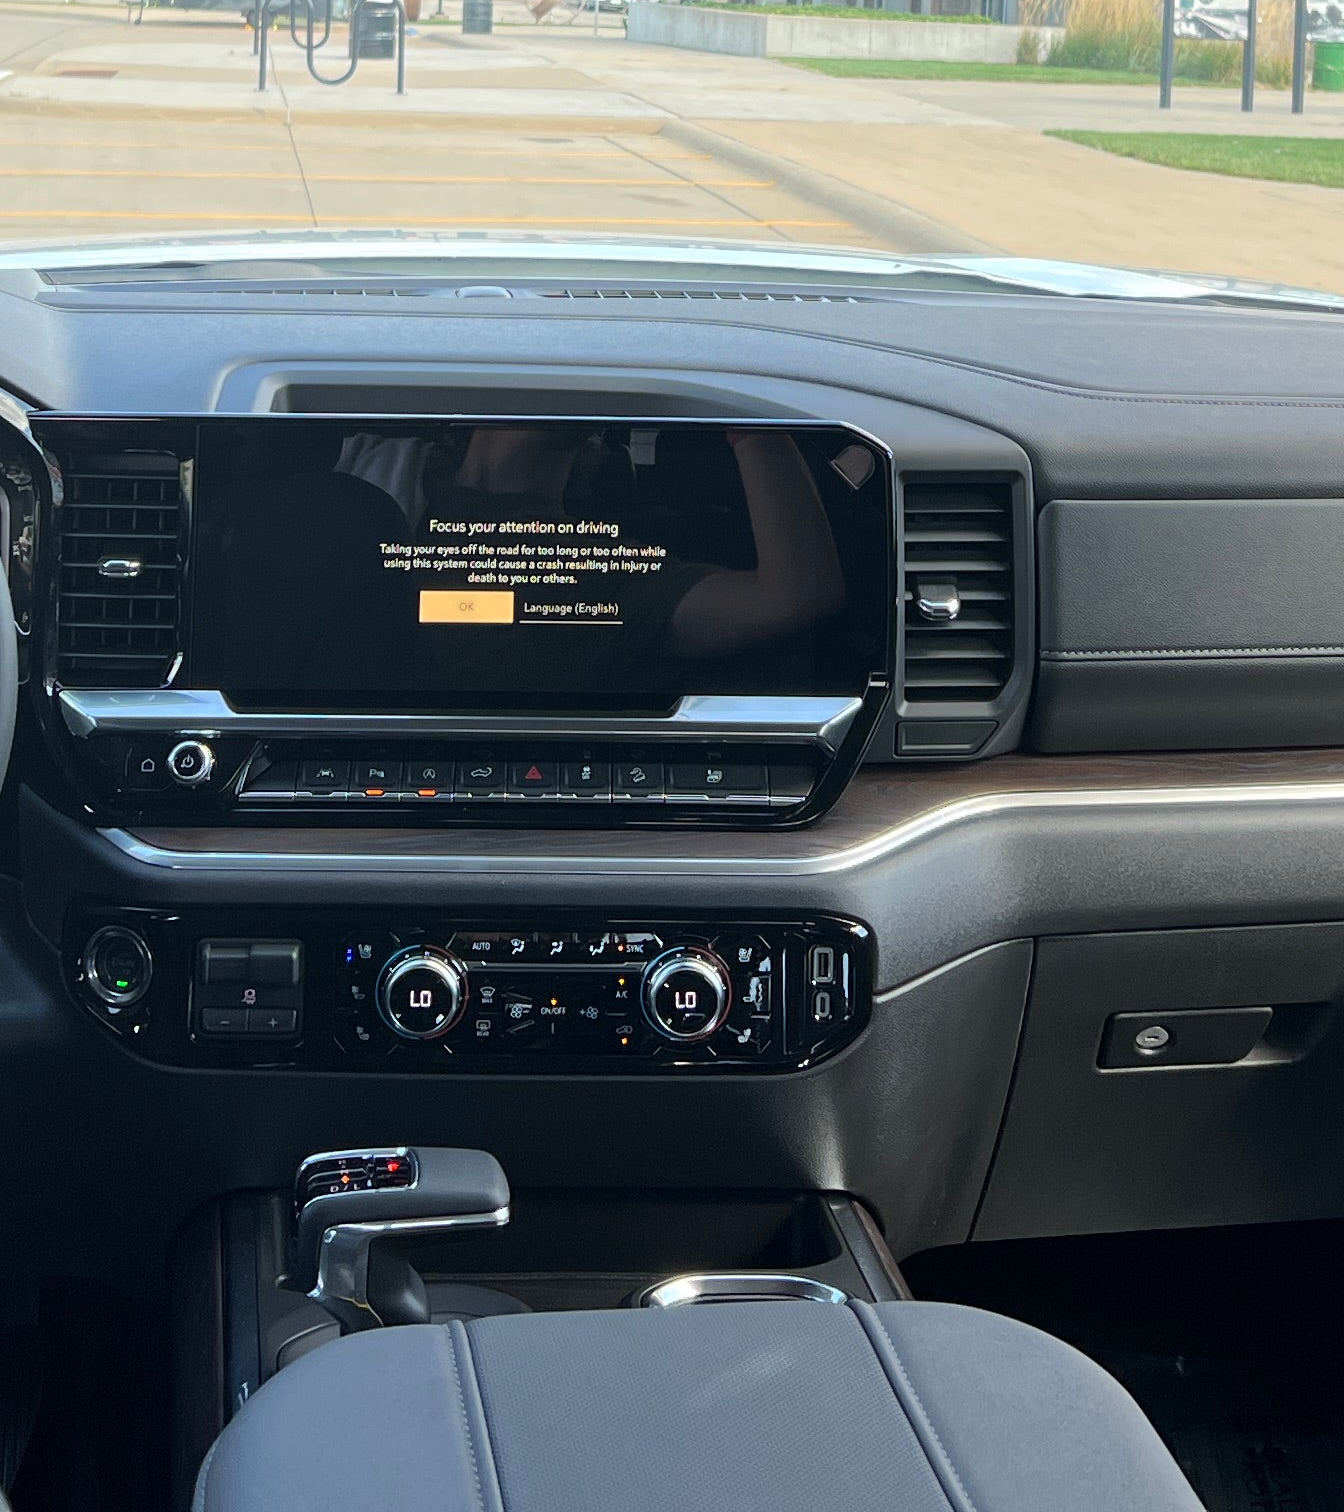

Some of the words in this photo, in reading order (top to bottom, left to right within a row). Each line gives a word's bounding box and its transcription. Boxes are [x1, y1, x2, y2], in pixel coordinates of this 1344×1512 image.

[429, 519, 466, 533] Focus
[468, 522, 497, 536] your
[498, 521, 555, 534] attention
[557, 523, 574, 534] on
[576, 520, 619, 538] driving
[379, 543, 412, 557] Taking
[413, 545, 436, 557] your
[437, 546, 460, 557] eyes
[461, 544, 477, 555] off
[478, 544, 495, 555] the
[496, 544, 520, 556] road
[520, 544, 536, 556] for
[537, 546, 555, 556] too
[556, 545, 578, 559] long
[580, 547, 592, 556] or
[593, 546, 610, 556] too
[611, 545, 638, 557] often
[640, 546, 667, 557] while
[383, 558, 411, 570] using
[412, 558, 432, 569] this
[433, 560, 468, 571] system
[469, 558, 497, 569] could
[498, 560, 527, 570] cause
[528, 561, 536, 570] a
[536, 558, 564, 570] crash
[565, 559, 608, 573] resulting
[609, 560, 620, 570] in
[621, 560, 649, 573] injury
[650, 562, 662, 571] or
[467, 572, 497, 583] death
[498, 574, 509, 583] to
[509, 574, 529, 586] you
[530, 574, 542, 584] or
[542, 573, 578, 584] others.
[459, 602, 474, 612] OK
[524, 602, 573, 616] Language
[574, 602, 619, 616] (English)
[472, 942, 491, 951] AUTO
[625, 944, 644, 954] SYNC
[409, 990, 432, 1008] LO
[615, 990, 628, 999] A/C
[675, 991, 697, 1009] LO
[540, 1006, 567, 1015] ON/OFF
